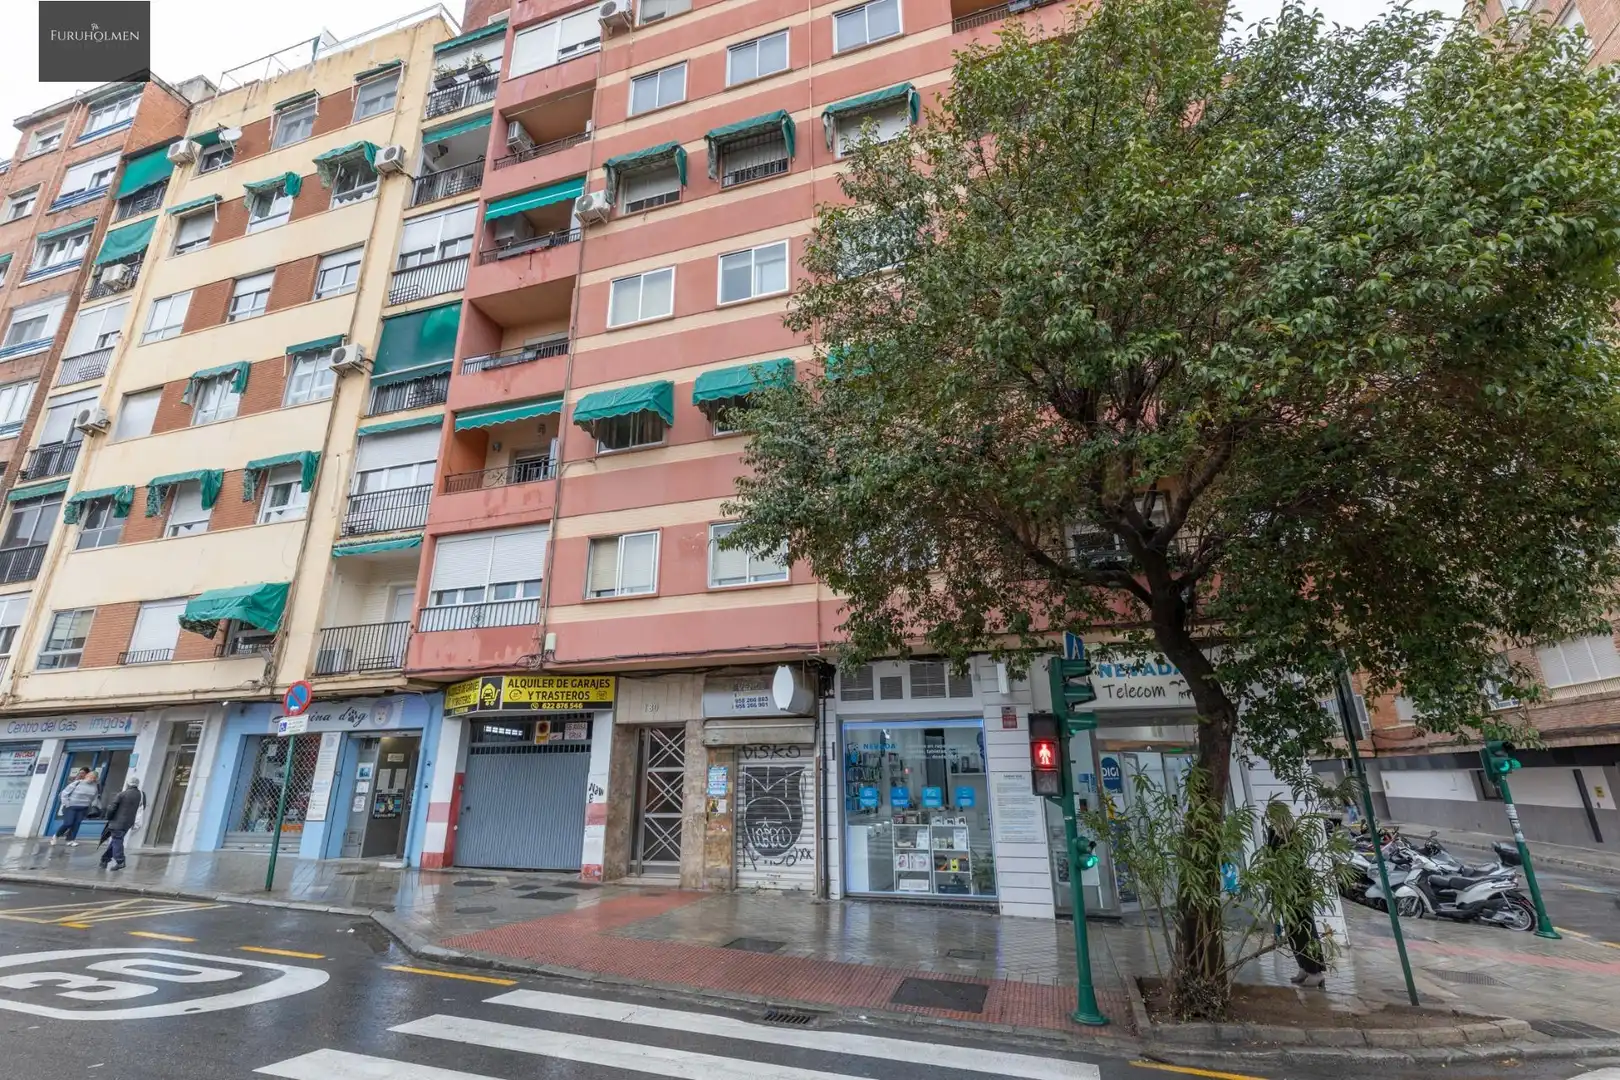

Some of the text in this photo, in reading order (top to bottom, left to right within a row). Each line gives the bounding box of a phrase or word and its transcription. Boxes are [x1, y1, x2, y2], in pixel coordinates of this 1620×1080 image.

[1098, 662, 1181, 679] NEVAD
[507, 678, 611, 691] ALQUILER DE GARAJES
[1102, 683, 1166, 699] Telecom
[527, 691, 534, 700] Y
[536, 690, 590, 700] TRASTEROS
[7, 716, 125, 734] Centro del Gas imgas
[1102, 767, 1119, 777] DIGI
[0, 958, 243, 1001] 30
